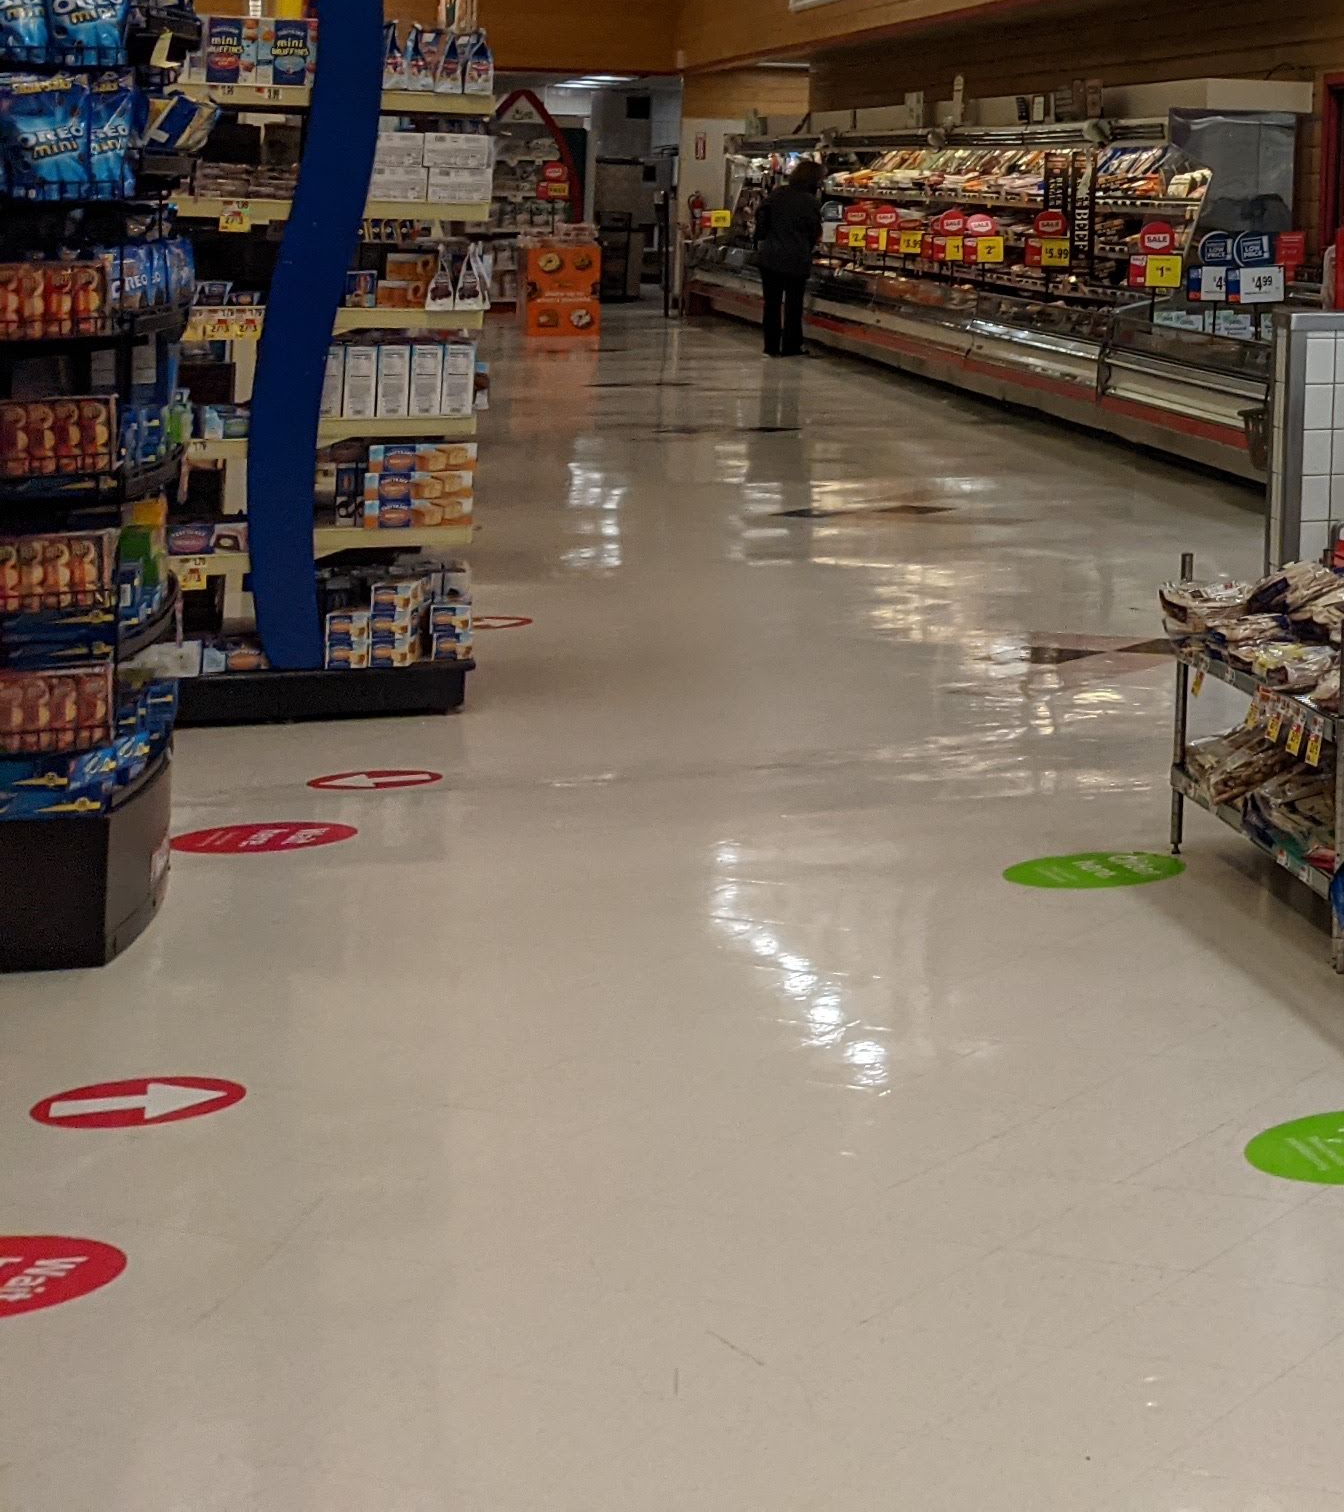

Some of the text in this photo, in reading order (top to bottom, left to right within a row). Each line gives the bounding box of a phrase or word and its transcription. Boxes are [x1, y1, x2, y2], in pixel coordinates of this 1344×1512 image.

[69, 9, 117, 24] mini
[211, 36, 238, 46] mini
[276, 38, 304, 48] mini
[19, 124, 84, 147] OREO
[33, 140, 78, 159] mini
[973, 222, 991, 230] SALE
[1041, 220, 1061, 229] SALE
[1074, 209, 1089, 251] BEEF
[1147, 235, 1168, 244] SALE
[1244, 244, 1262, 252] LOW
[1045, 247, 1069, 261] $5.99
[1243, 250, 1263, 259] PRICE
